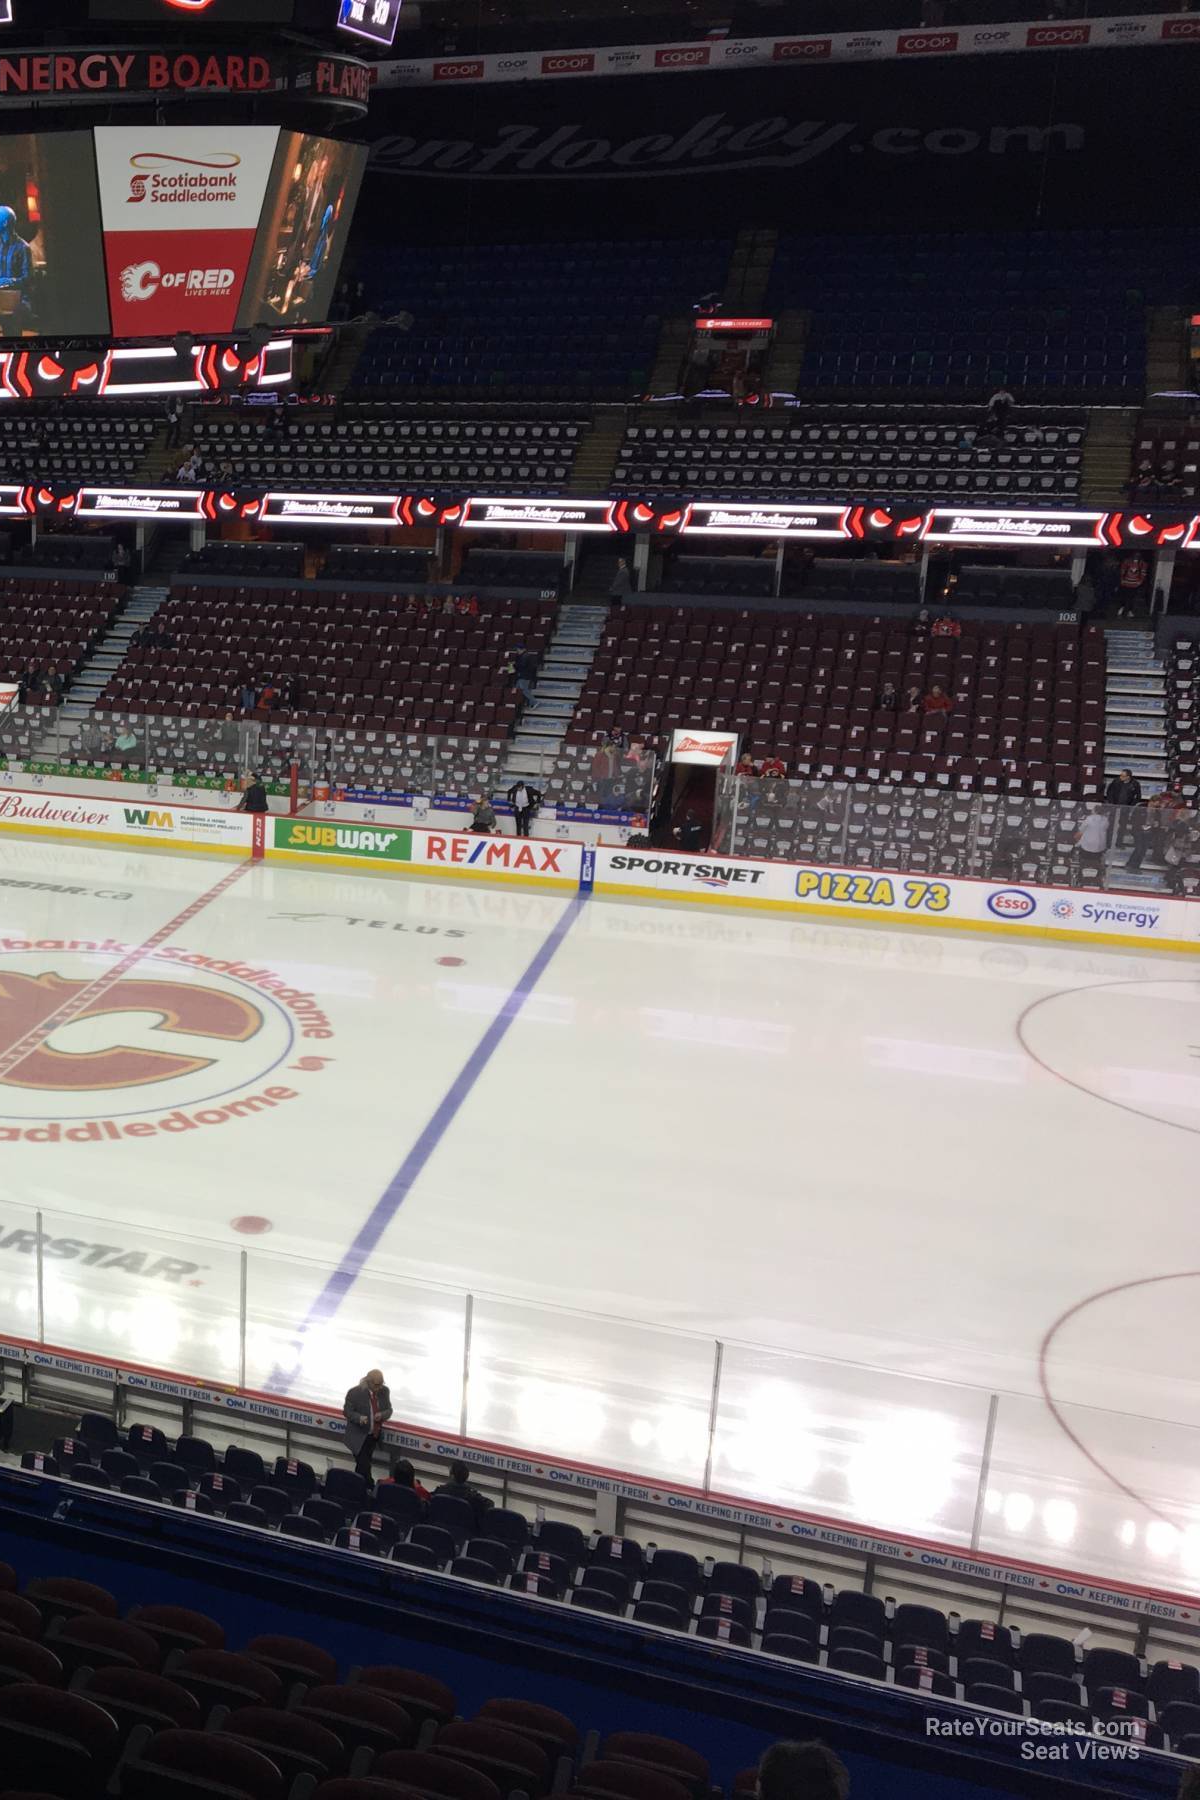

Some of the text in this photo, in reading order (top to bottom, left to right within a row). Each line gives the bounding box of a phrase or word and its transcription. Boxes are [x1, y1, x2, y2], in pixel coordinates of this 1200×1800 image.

[148, 55, 271, 89] BOARD
[370, 112, 1085, 172] enHockey.com
[152, 173, 237, 187] Scotiabank
[151, 189, 236, 203] Saddledome
[162, 273, 186, 287] OF
[186, 269, 235, 289] RED
[1059, 613, 1076, 621] 108
[678, 739, 728, 752] Budweiser
[124, 808, 174, 828] WM
[288, 825, 398, 852] SUBWAY
[426, 836, 562, 873] RE/MAX
[609, 856, 765, 883] SPORTSNET
[796, 870, 951, 911] PIZZA 73
[995, 896, 1029, 910] Esso
[346, 916, 466, 938] TELUS
[1082, 904, 1159, 928] Synergy
[151, 946, 334, 1041] Saddledome
[56, 1359, 83, 1372] KEEPING
[84, 1364, 91, 1373] IT
[92, 1366, 113, 1380] FRESH
[250, 1403, 280, 1417] KEEPING
[282, 1408, 288, 1418] IT
[290, 1410, 313, 1425] FRESH
[577, 1476, 610, 1491] KEEPING
[613, 1482, 620, 1493] IT
[622, 1485, 649, 1499] FRESH
[820, 1530, 858, 1547] KEEPING
[860, 1538, 868, 1549] IT
[871, 1541, 900, 1557] FRESH
[951, 1560, 990, 1577] KEEPING
[993, 1568, 1002, 1579] IT
[1005, 1571, 1034, 1587] FRESH
[1089, 1590, 1129, 1608] KEEPING
[1132, 1599, 1141, 1610] IT
[1144, 1601, 1176, 1618] FRESH
